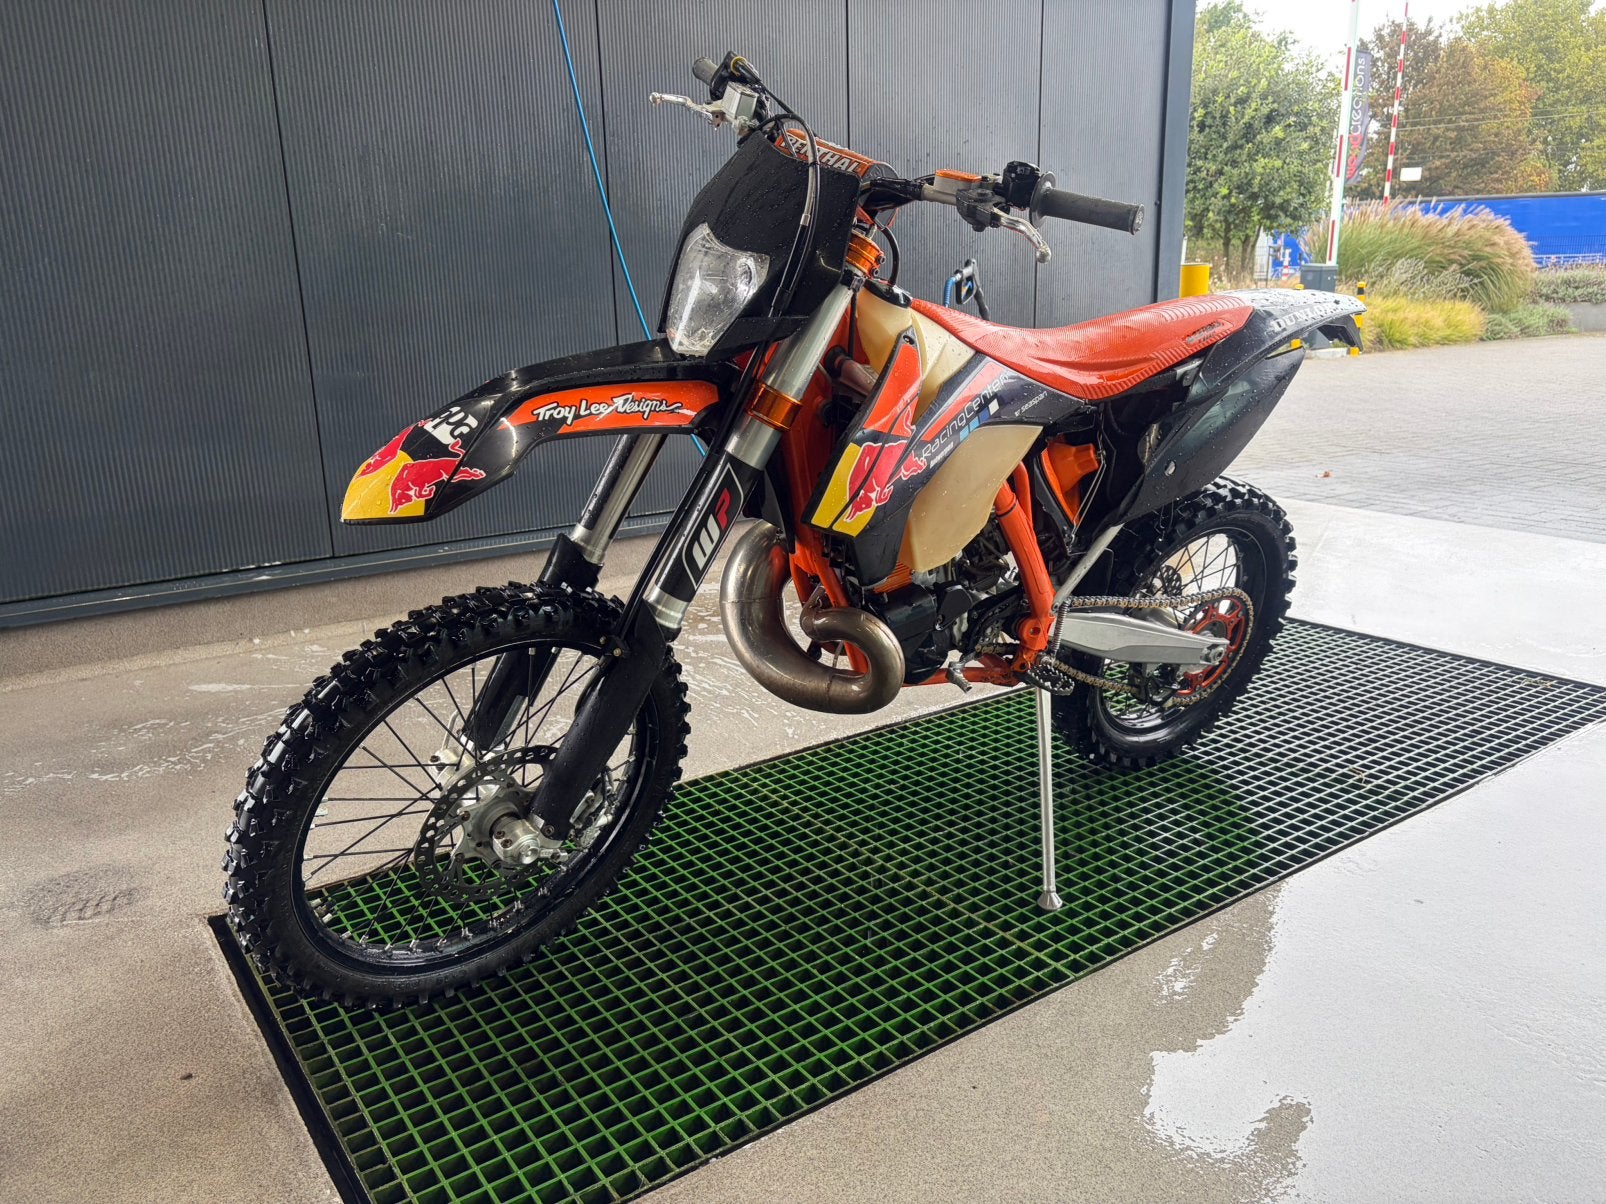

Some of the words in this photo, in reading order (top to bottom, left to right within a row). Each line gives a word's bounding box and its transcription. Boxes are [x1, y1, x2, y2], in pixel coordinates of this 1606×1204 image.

[533, 402, 576, 425] Troy
[579, 399, 612, 417] Lee
[610, 392, 682, 420] Designs
